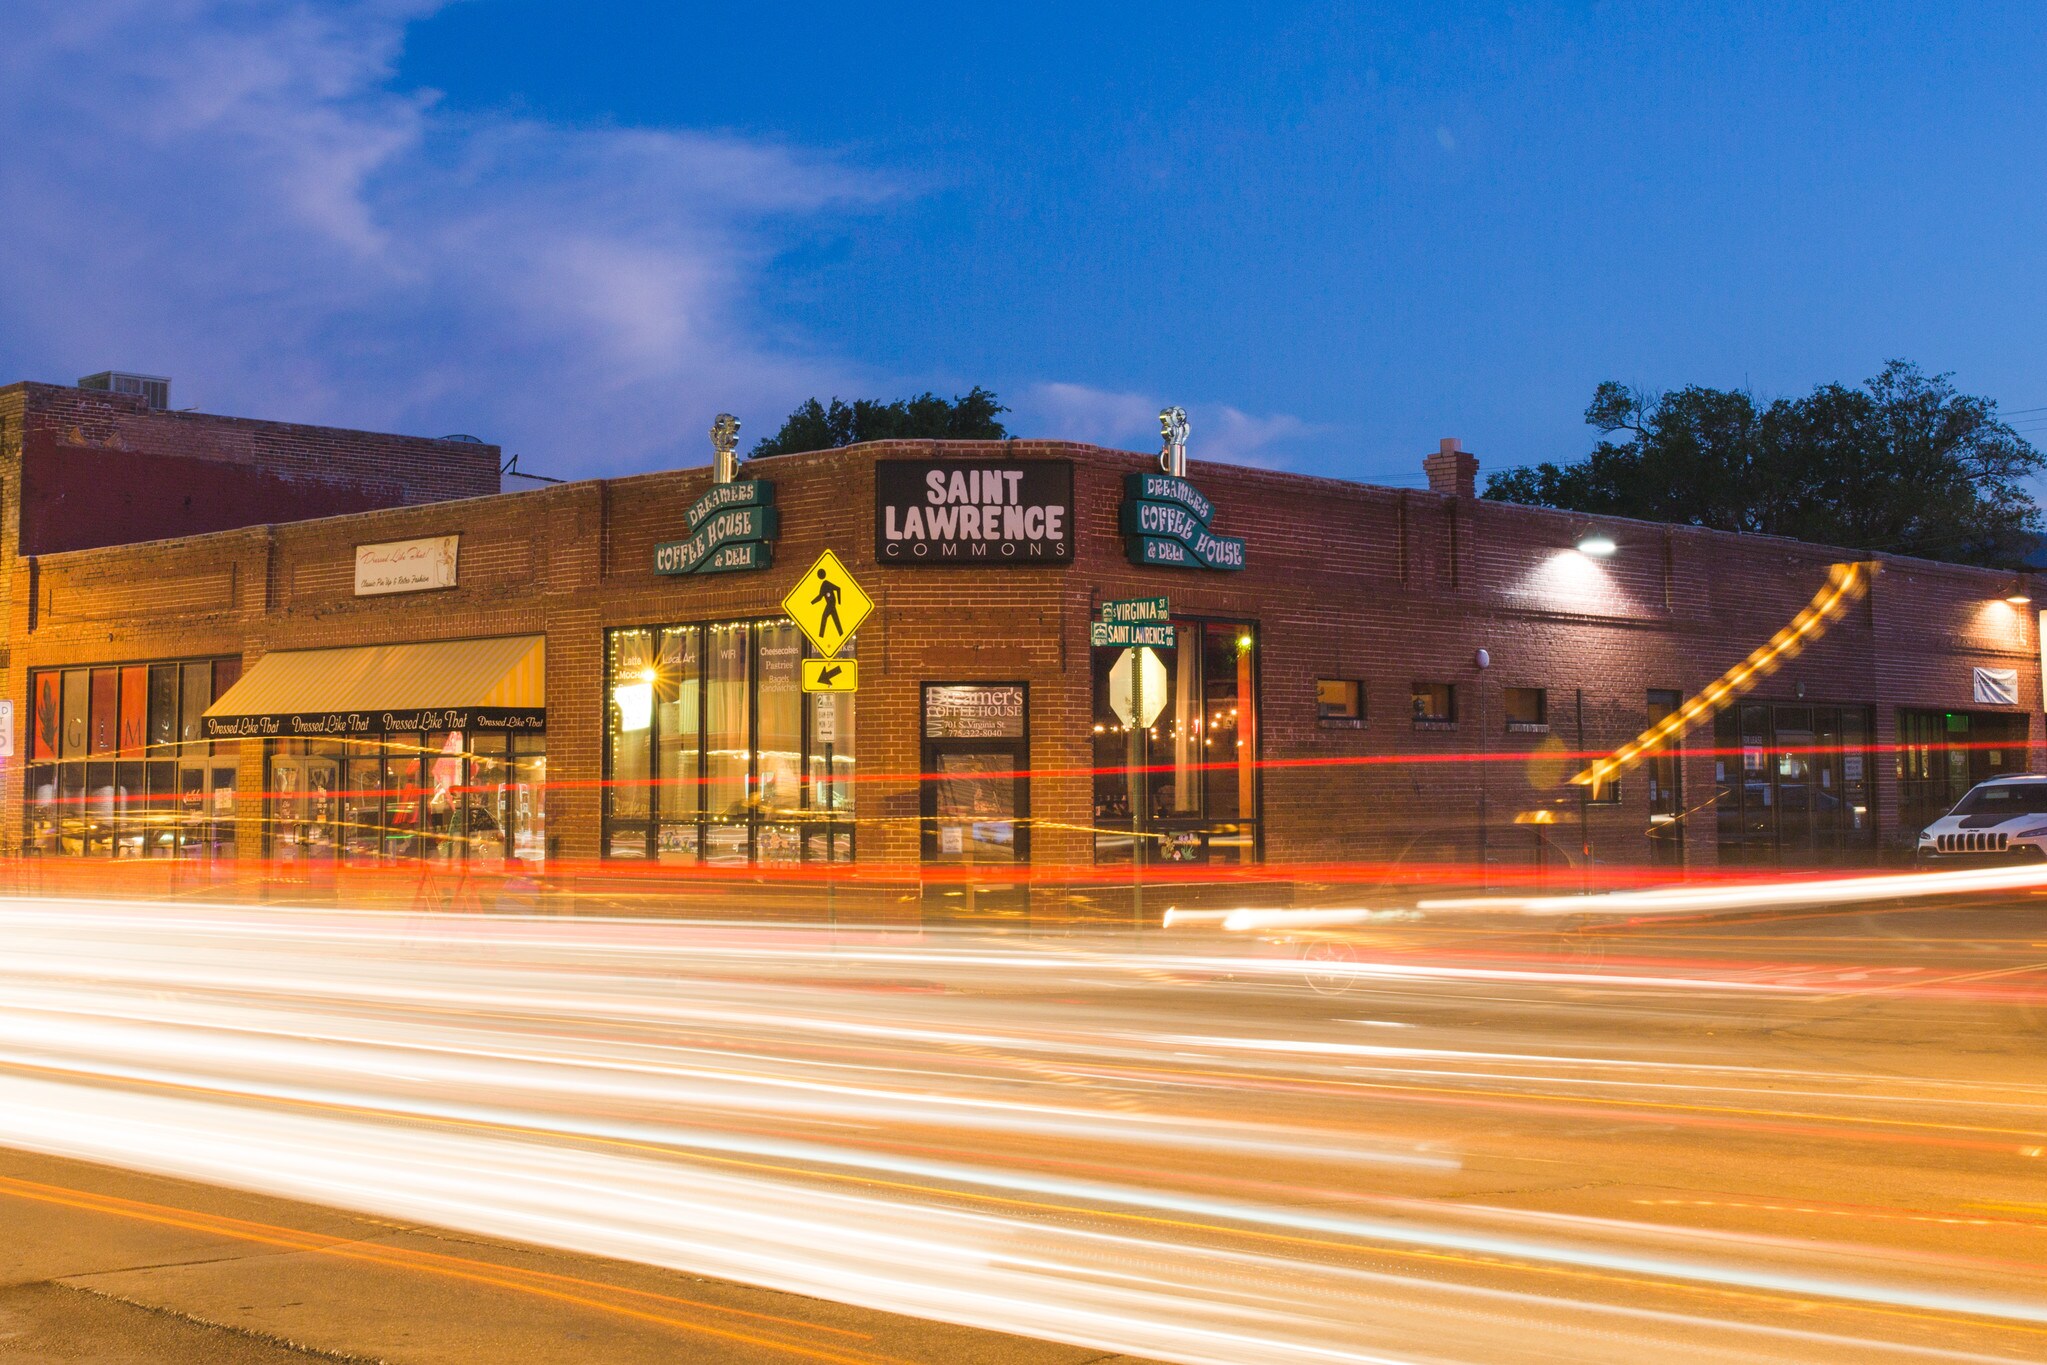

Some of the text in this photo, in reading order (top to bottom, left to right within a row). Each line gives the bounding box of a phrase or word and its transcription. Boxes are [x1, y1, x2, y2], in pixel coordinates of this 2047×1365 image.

[926, 470, 1023, 505] SAINT
[689, 485, 753, 526] DREAMERS
[1147, 479, 1209, 518] DREAMERS
[885, 505, 1064, 540] LAWRENCE
[657, 512, 752, 570] COFFEE HOUSE
[1141, 505, 1242, 565] COFFEE HOUSE
[715, 547, 751, 567] & DELI
[886, 542, 1065, 556] COMMONS
[1147, 542, 1184, 561] & DELI
[1117, 602, 1156, 620] VIRGINIA
[1159, 599, 1165, 608] ST
[1158, 610, 1167, 619] 700
[1108, 625, 1129, 643] SAINT
[1131, 626, 1165, 644] LAWRENCE
[662, 652, 695, 664] Local Art
[760, 646, 799, 656] Cheesecakes
[623, 656, 642, 666] Latte
[765, 661, 793, 669] Pastries
[760, 684, 797, 692] Sandwiches
[769, 674, 789, 684] Bagels
[927, 687, 1022, 705] Dreamer's
[383, 710, 468, 730] Dressed Like That
[927, 706, 1022, 716] COFFEE HOUSE
[208, 718, 239, 735] Dressed
[239, 717, 258, 735] Like
[260, 717, 280, 733] That
[292, 713, 370, 733] Dressed Like That
[478, 716, 543, 727] Dressed Like That
[967, 721, 995, 730] Virginia
